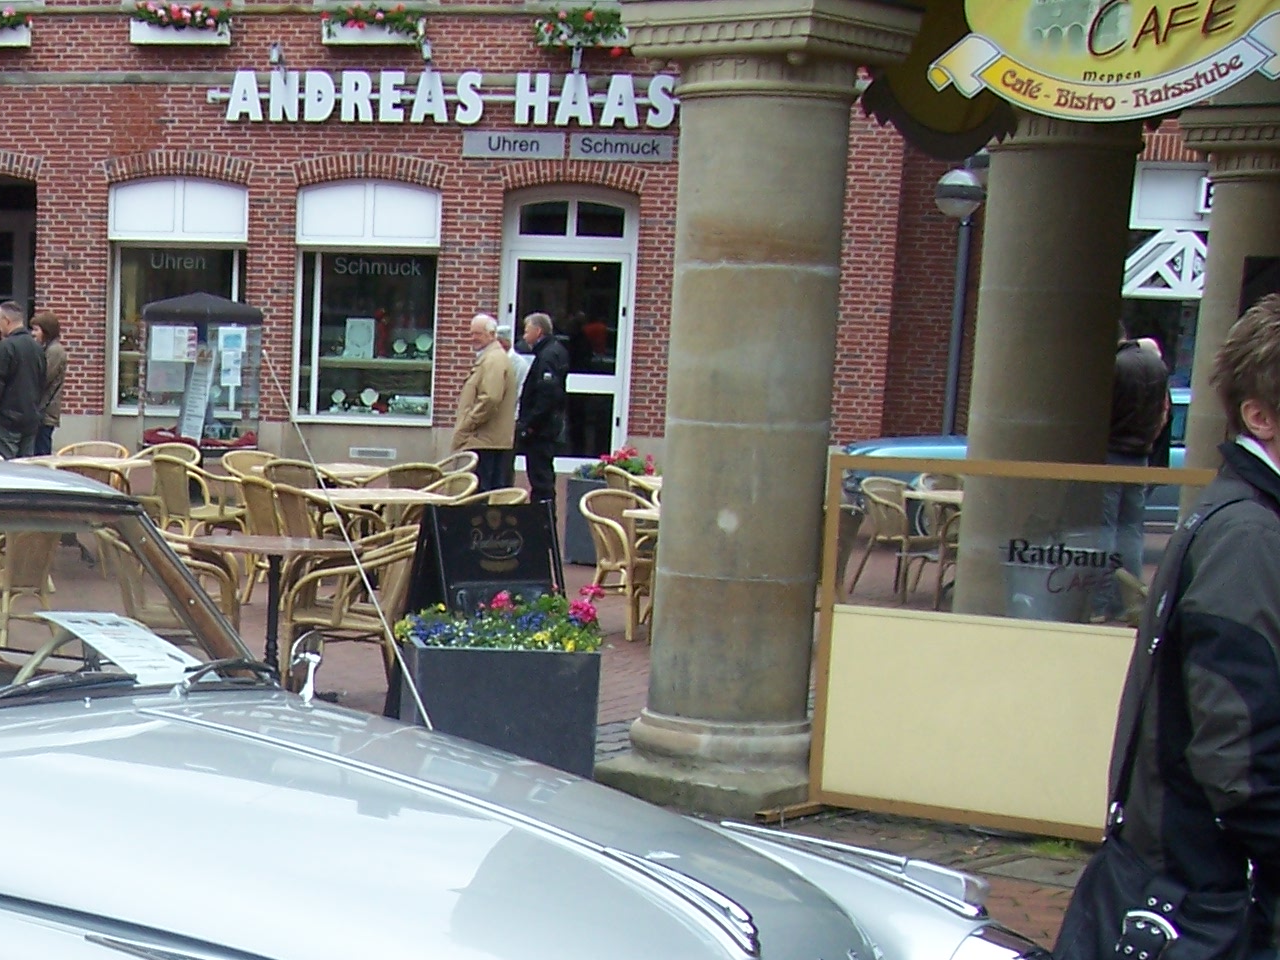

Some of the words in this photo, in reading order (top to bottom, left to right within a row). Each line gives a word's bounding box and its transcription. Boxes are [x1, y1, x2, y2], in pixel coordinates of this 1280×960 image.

[1001, 69, 1041, 100] Café
[1053, 88, 1116, 112] Bistro
[1132, 54, 1244, 108] Ratsstube
[1083, 70, 1141, 83] Meppen
[225, 70, 483, 124] ANDREAS
[514, 72, 677, 128] HAAS
[487, 136, 541, 153] Uhren
[580, 138, 660, 157] Schmuck
[150, 252, 207, 270] Uhren
[334, 257, 421, 277] Schmuck
[1007, 539, 1123, 568] Rathaus
